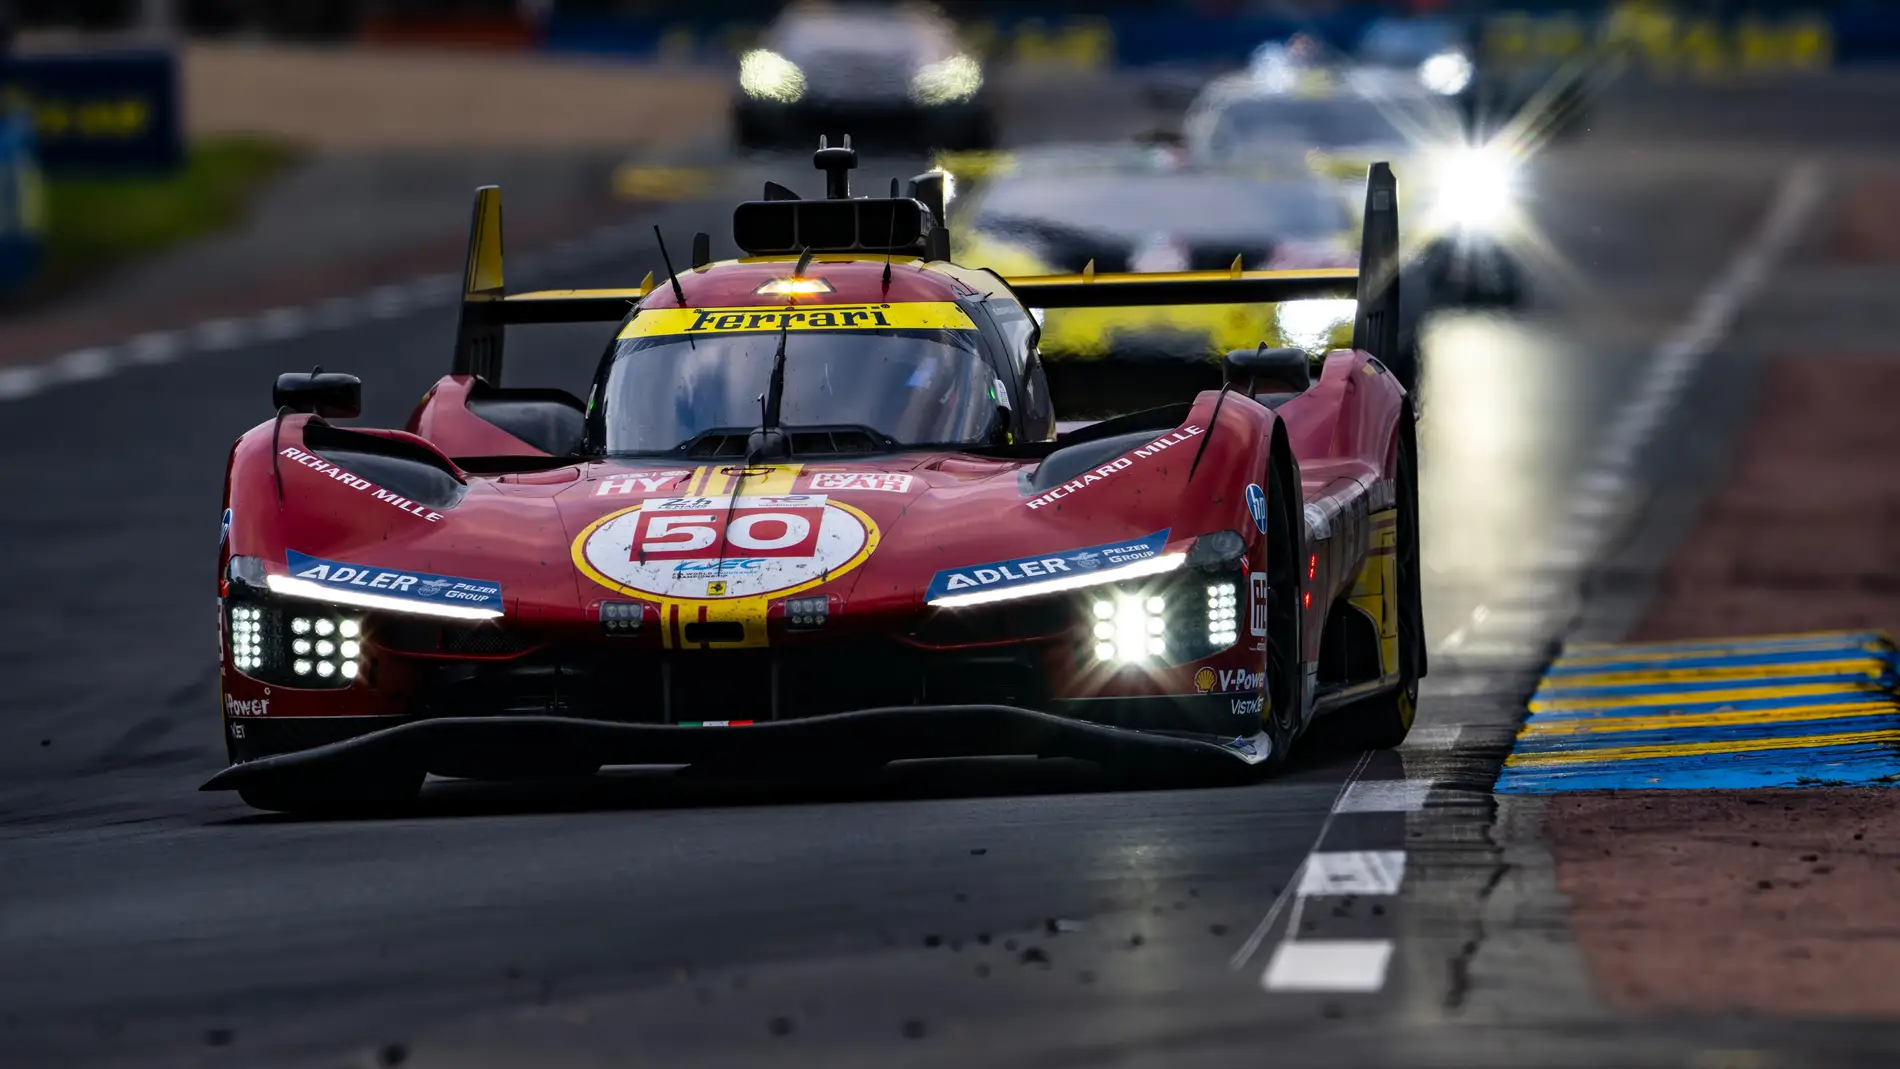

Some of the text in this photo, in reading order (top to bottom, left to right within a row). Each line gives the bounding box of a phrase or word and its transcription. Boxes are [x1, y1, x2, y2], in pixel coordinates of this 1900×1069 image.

[684, 303, 891, 332] Ferrari
[818, 473, 907, 482] HYPER
[1025, 424, 1205, 510] RICHARD MILLE
[279, 446, 444, 523] RICHARD MILLE
[596, 476, 676, 496] HY
[815, 479, 905, 492] CAR
[1249, 486, 1267, 533] hp
[641, 513, 811, 553] 50
[1102, 542, 1151, 557] PELZER
[1108, 549, 1155, 564] GROUP
[296, 564, 419, 592] ADLER
[946, 557, 1071, 591] ADLER
[444, 590, 489, 602] GROUP
[451, 581, 498, 595] PELZER
